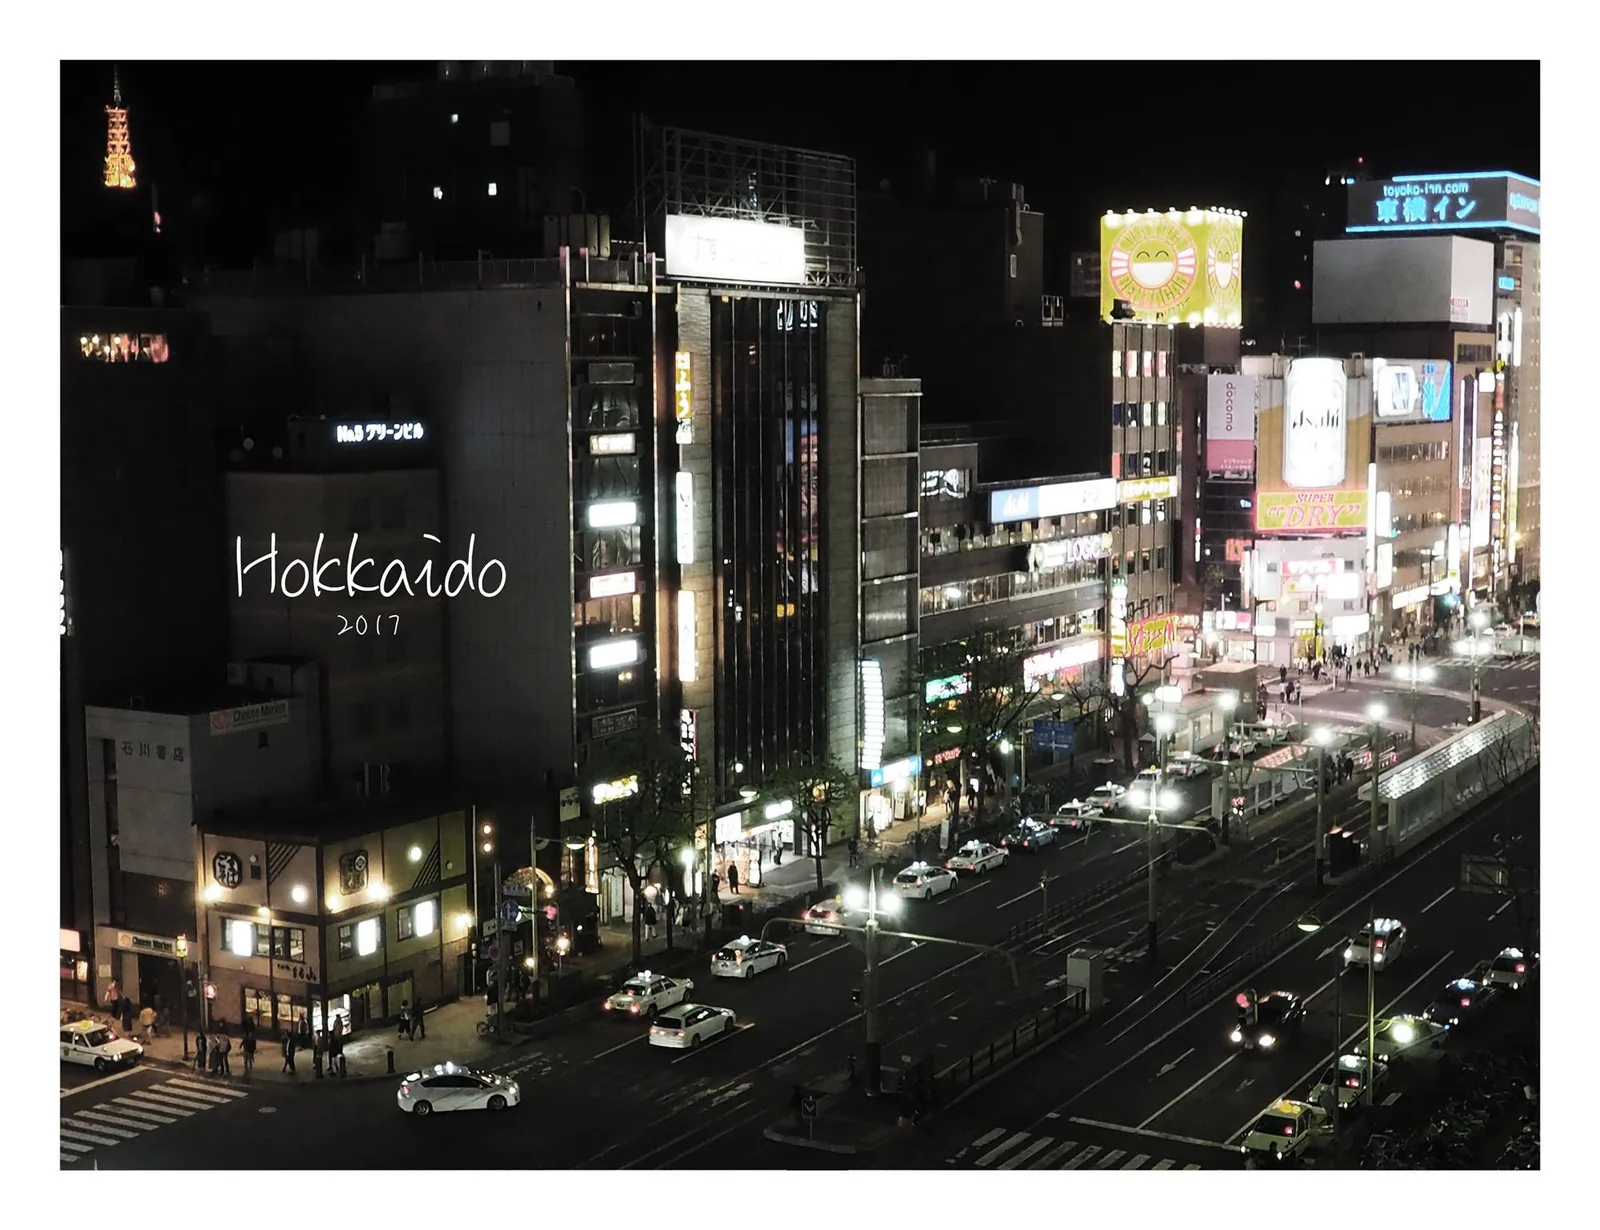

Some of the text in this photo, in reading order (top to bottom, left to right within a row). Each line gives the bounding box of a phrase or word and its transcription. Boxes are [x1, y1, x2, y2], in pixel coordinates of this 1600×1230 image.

[1376, 197, 1476, 223] 東横イン
[1226, 381, 1236, 432] docomo
[1295, 493, 1335, 504] SUPER
